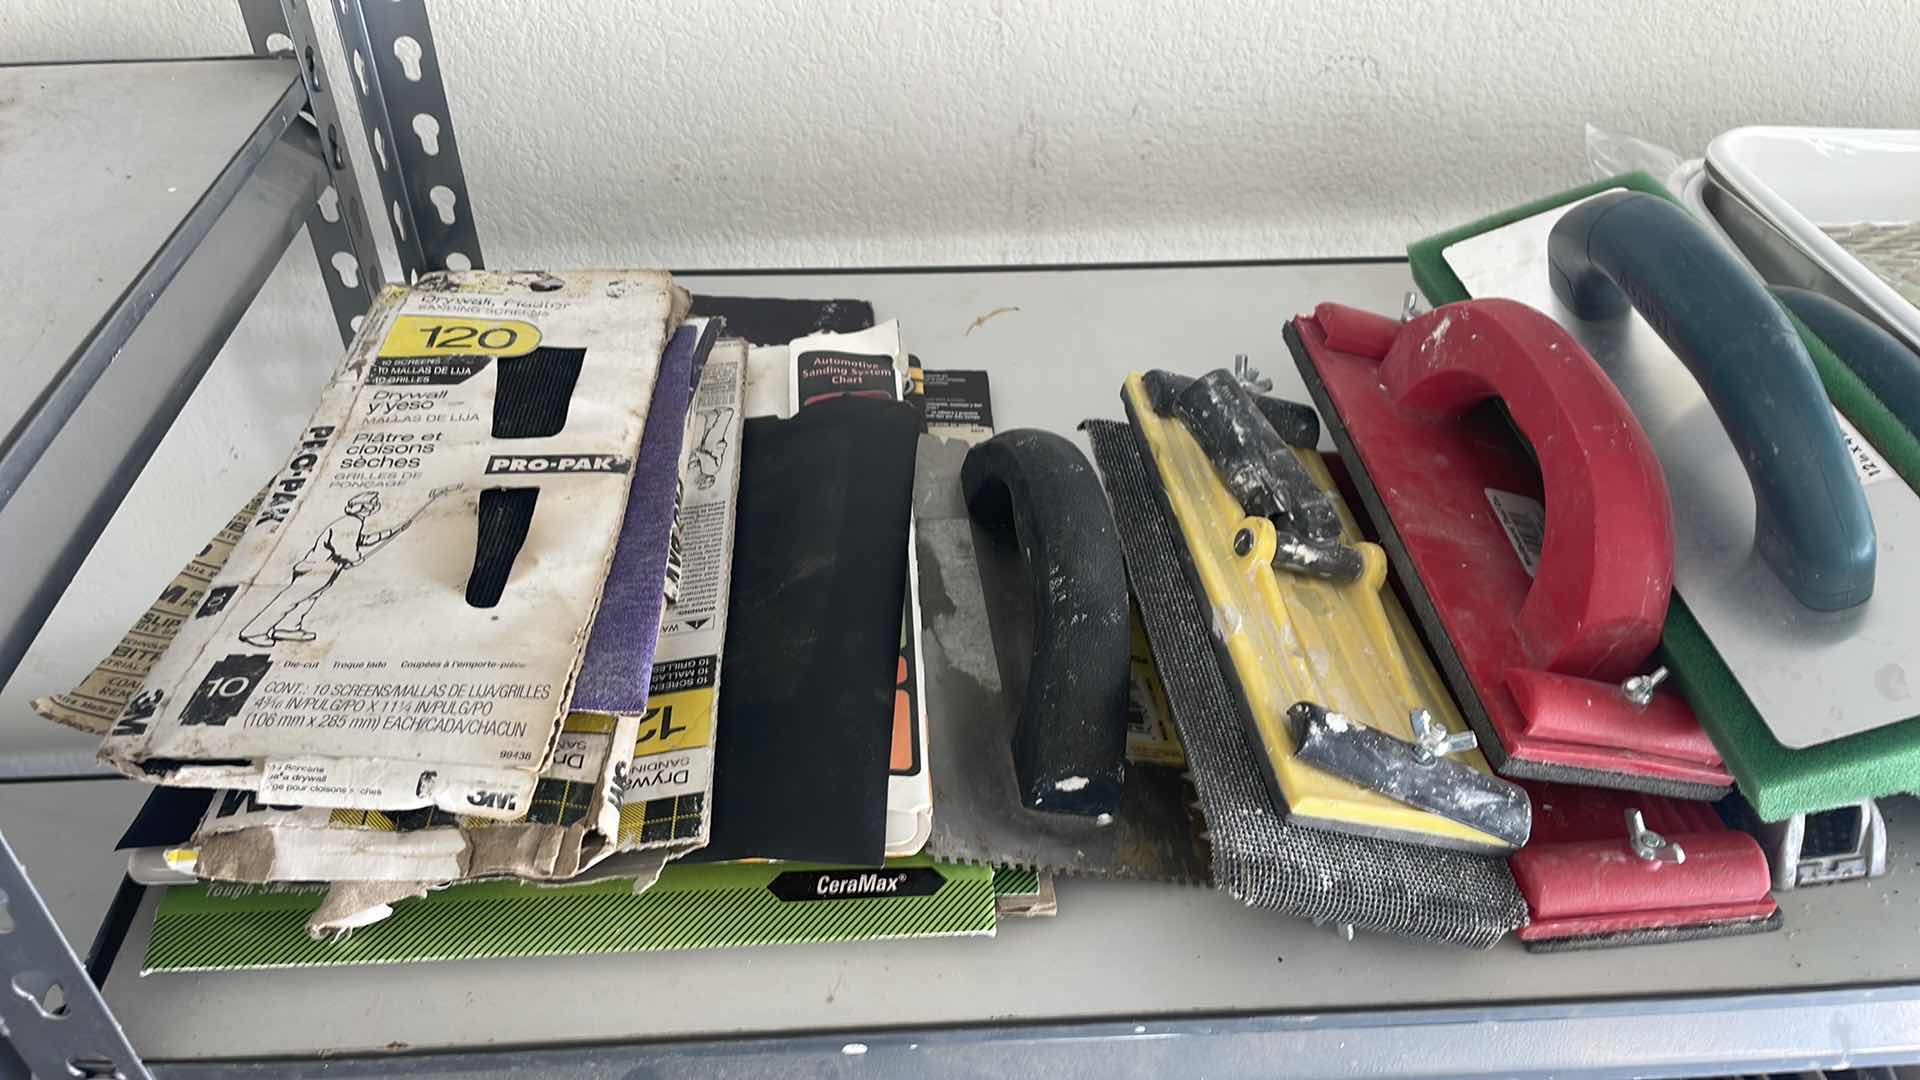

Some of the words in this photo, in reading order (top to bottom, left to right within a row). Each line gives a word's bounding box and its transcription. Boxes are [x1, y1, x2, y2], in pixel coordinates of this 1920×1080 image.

[419, 325, 518, 349] 120
[394, 358, 442, 366] SCREENS
[813, 356, 880, 370] Automotive
[377, 367, 388, 375] 10
[390, 366, 432, 376] MALLAS
[434, 366, 448, 375] DE
[450, 366, 472, 376] LIJA
[802, 367, 848, 378] Sanding
[850, 368, 892, 379] System
[831, 375, 865, 385] Chart
[373, 389, 449, 401] Drywall
[367, 400, 381, 416] y
[383, 400, 434, 415] yeso
[362, 416, 423, 425] MALLAS
[426, 414, 445, 423] DE
[450, 413, 480, 423] LIJA
[353, 431, 415, 444] Plâtre
[421, 431, 444, 442] et
[345, 443, 435, 455] cloisons
[340, 455, 421, 469] sèches
[491, 457, 612, 471] PRO-PAK
[402, 472, 423, 480] DE
[206, 677, 250, 698] 10
[313, 684, 331, 696] 10
[331, 683, 448, 698] SCREENS/MALLAS
[449, 685, 466, 697] DE
[468, 685, 552, 699] LIJA/GRILLES
[285, 697, 365, 712] IN/PULG/PO
[414, 700, 494, 716] IN/PULG/PO
[243, 711, 278, 729] (106
[278, 713, 308, 727] mm
[307, 716, 317, 727] x
[318, 714, 348, 727] 285
[349, 715, 382, 732] mm)
[382, 715, 529, 738] EACH/CADA/CHACUN
[292, 774, 328, 783] drywall
[286, 784, 308, 792] pour
[310, 784, 347, 794] cloisons
[207, 882, 255, 900] Tough
